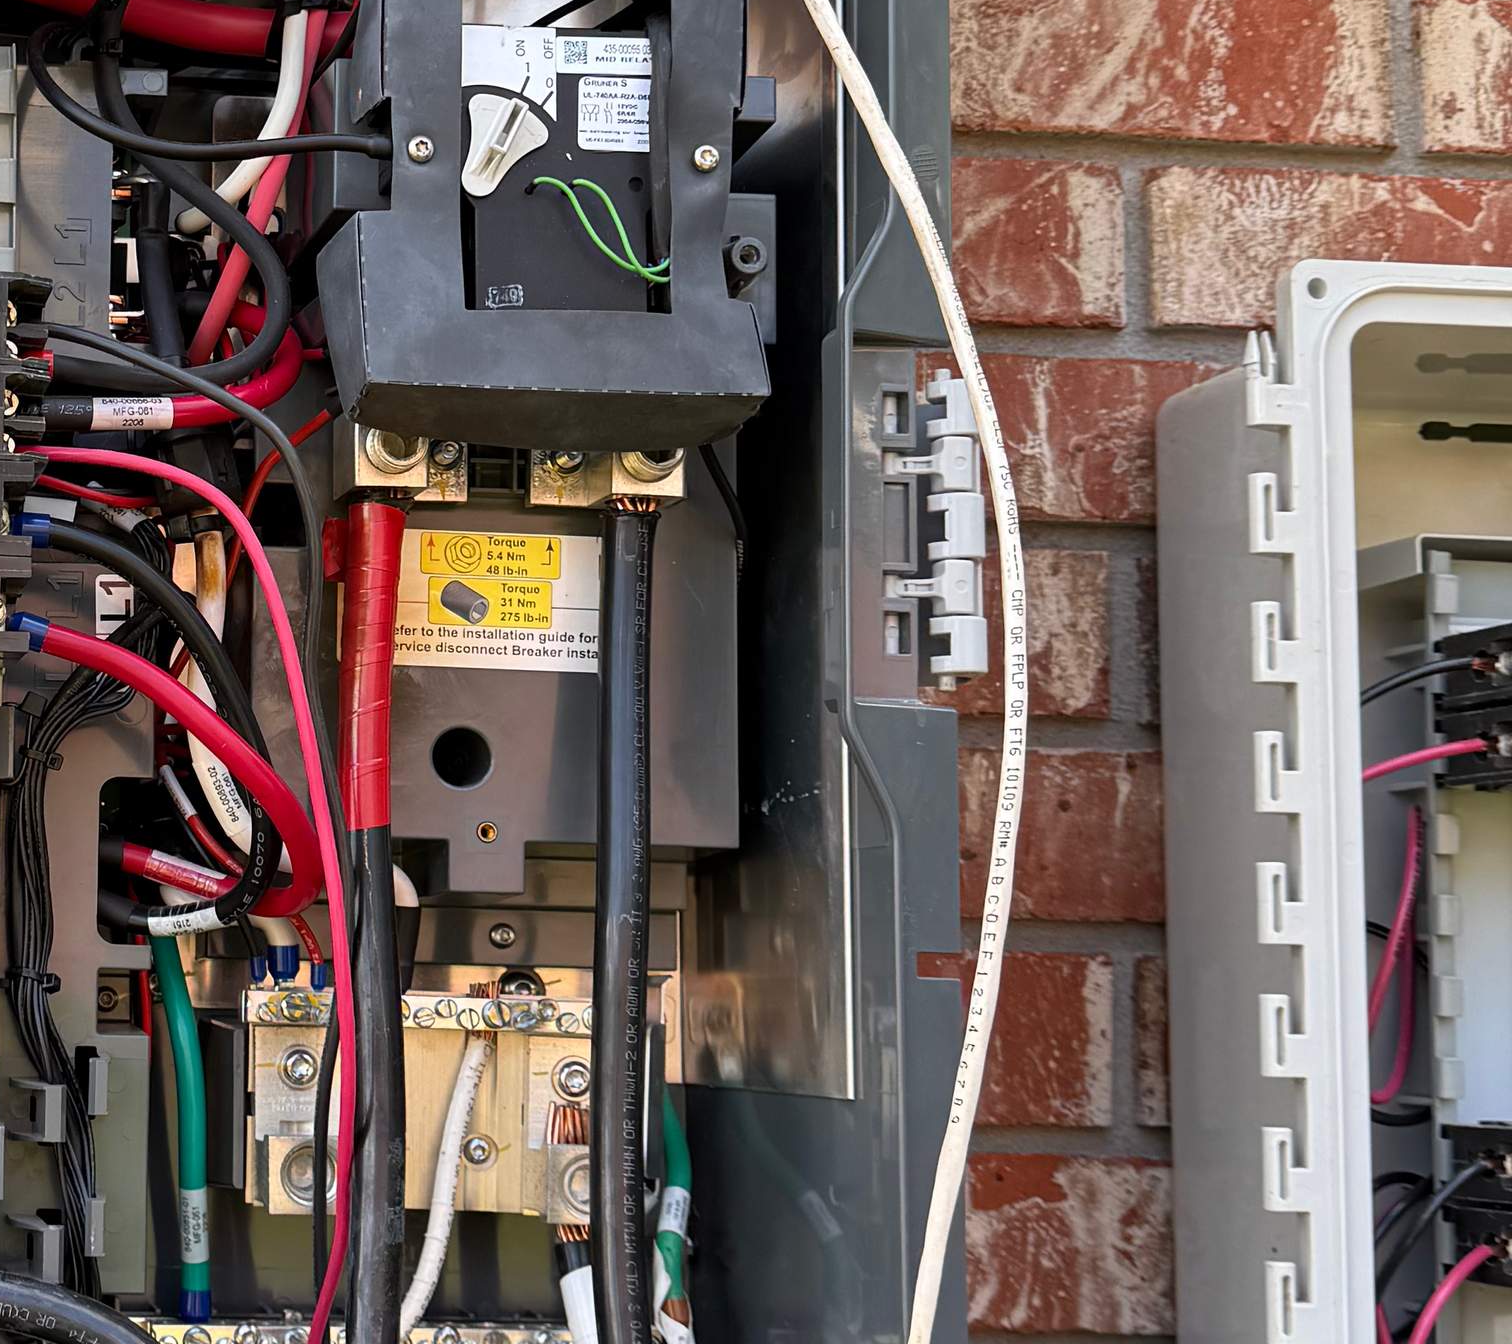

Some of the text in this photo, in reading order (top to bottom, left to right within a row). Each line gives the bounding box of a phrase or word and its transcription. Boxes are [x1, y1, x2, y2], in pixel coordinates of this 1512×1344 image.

[516, 39, 525, 57] ON
[544, 38, 553, 59] OFF
[525, 62, 530, 73] 1
[488, 537, 527, 549] Torque
[487, 551, 525, 561] 5.4 Nm
[486, 566, 528, 576] 48 lb-in
[501, 584, 540, 595] Torque
[501, 598, 536, 608] 31 Nm
[500, 612, 549, 623] 275 lb-in
[421, 627, 598, 644] to the installation guide for
[394, 642, 562, 658] ervice disconnect Breaker
[1001, 588, 1025, 812] CMP OR FPLP OR FT6 10109
[208, 766, 239, 823] 840-00893-02
[252, 832, 264, 884] 10070
[623, 581, 647, 1217] OR THHN OR OR OR FOR
[35, 1313, 57, 1329] OR
